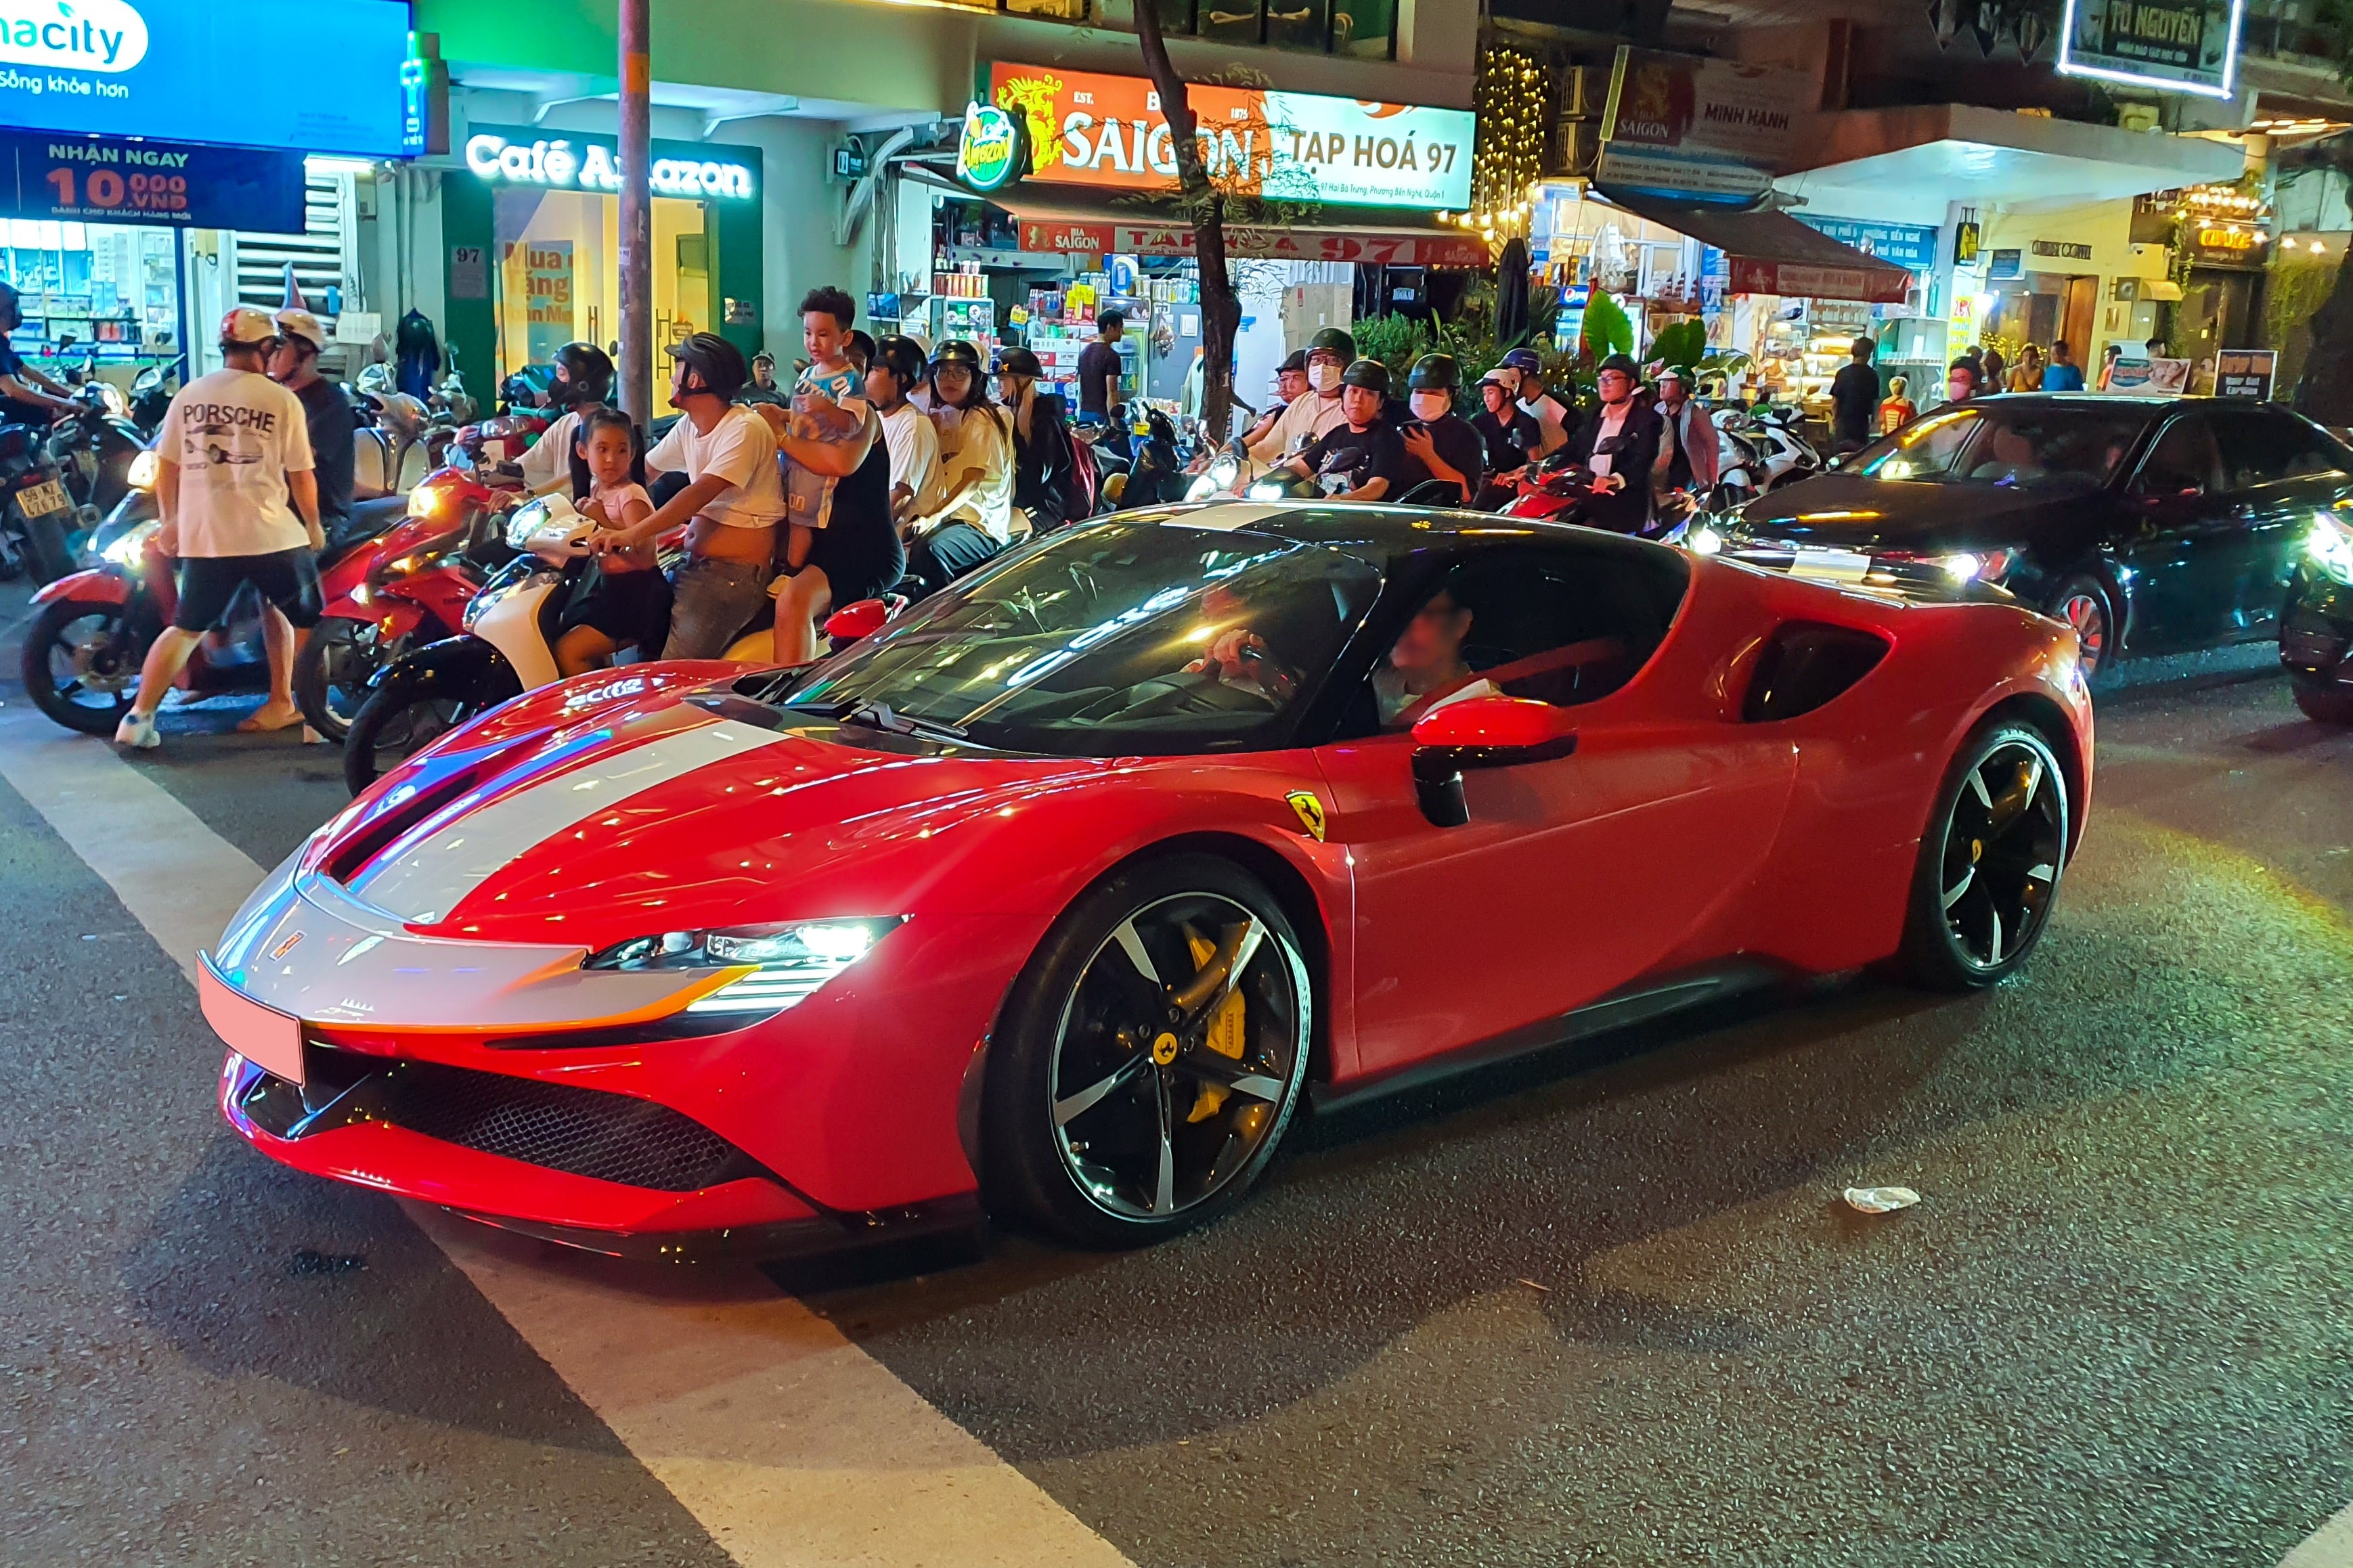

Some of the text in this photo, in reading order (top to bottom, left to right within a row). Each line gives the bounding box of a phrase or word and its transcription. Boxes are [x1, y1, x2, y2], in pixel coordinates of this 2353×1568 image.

[0, 2, 123, 64] acity
[1074, 91, 1094, 104] EST.
[1705, 103, 1744, 125] MINH
[1620, 119, 1669, 138] SAIGON
[49, 143, 189, 167] NHẬN NGAY
[1288, 129, 1457, 174] TẠP HOÁ 97
[465, 134, 753, 198] Café Aazon
[1329, 183, 1339, 192] Hai
[1055, 236, 1099, 250] SAIGON
[1320, 238, 1406, 263] 97
[456, 248, 480, 264] 97
[183, 403, 276, 433] PORSCHE
